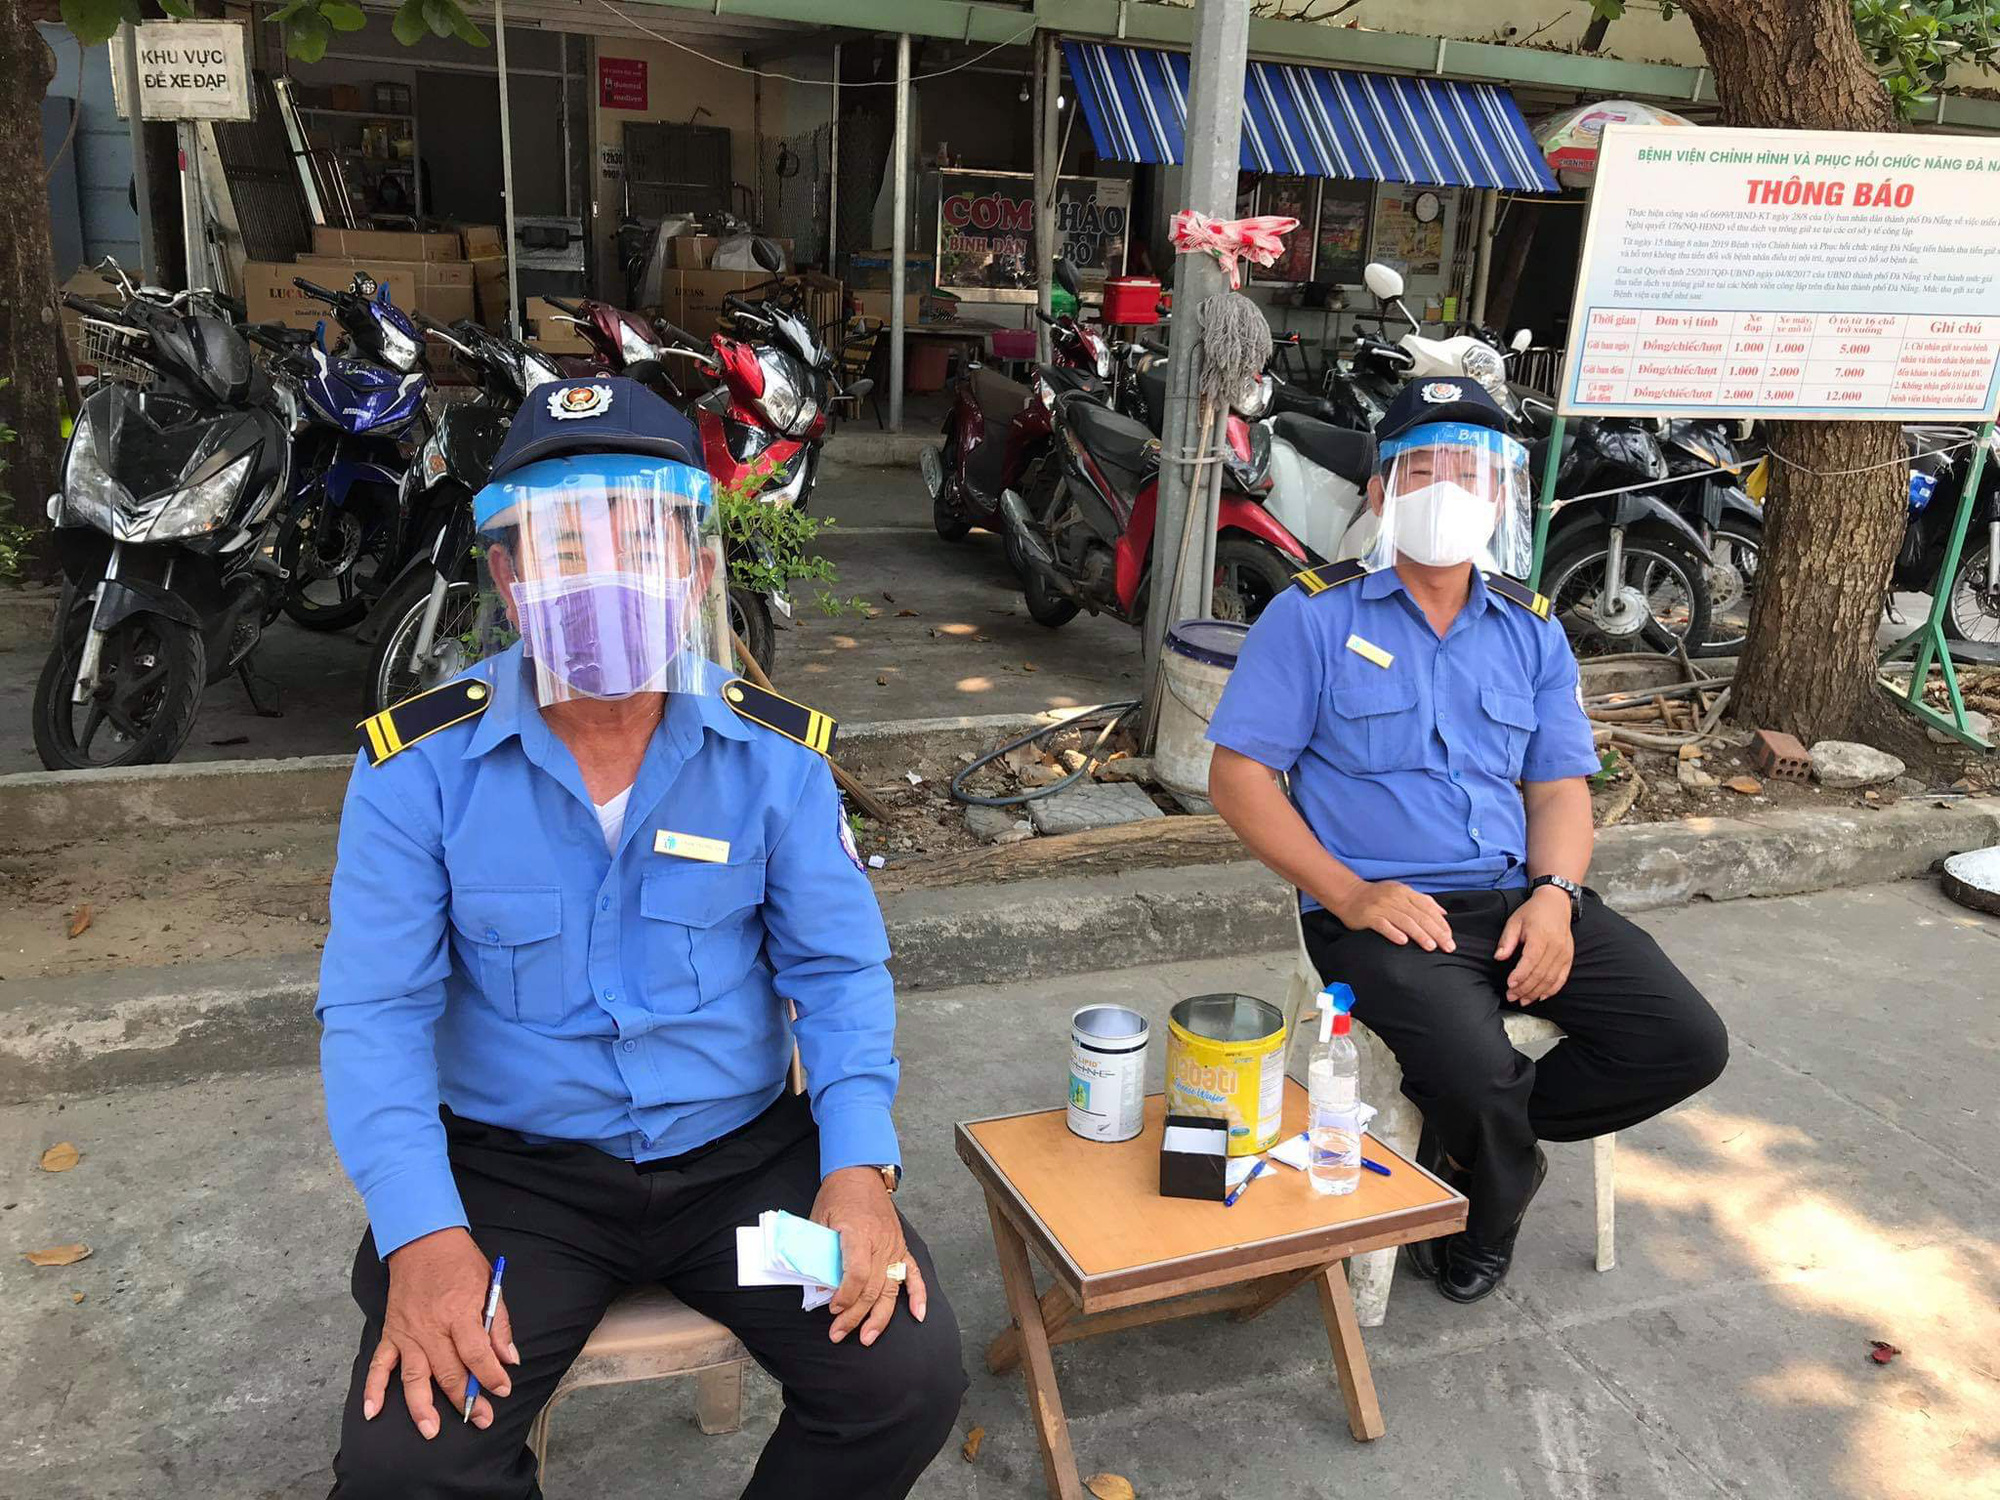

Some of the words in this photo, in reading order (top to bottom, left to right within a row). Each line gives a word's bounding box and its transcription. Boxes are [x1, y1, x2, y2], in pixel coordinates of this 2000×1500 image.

[142, 50, 178, 64] KHU
[184, 50, 222, 67] VỰC
[170, 74, 192, 87] XE
[194, 74, 226, 91] ĐẠP
[1638, 146, 1672, 163] BỆNH
[1677, 147, 1706, 165] VIỆN
[1710, 148, 1752, 163] CHỈNH
[1757, 150, 1789, 164] HÌNH
[1794, 151, 1810, 165] VÀ
[1815, 155, 1851, 169] PHỤC
[1855, 150, 1879, 167] HỒI
[1882, 154, 1921, 168] CHỨC
[1925, 156, 1962, 170] NĂNG
[1966, 157, 1983, 170] ĐÀ
[1747, 175, 1845, 205] THÔNG
[1853, 178, 1914, 207] BÁO
[943, 191, 1033, 230] CƠM
[1055, 195, 1124, 235] HÁO
[950, 233, 987, 252] BÌNH
[992, 234, 1028, 255] DÂN
[268, 288, 310, 299] LUCA
[1593, 313, 1613, 324] Thời
[1616, 316, 1636, 326] gian
[1656, 315, 1678, 326] Đơn
[1683, 316, 1693, 328] vị
[1696, 316, 1718, 327] tính
[1931, 321, 1955, 333] Ghi
[1959, 322, 1982, 334] chú
[1643, 339, 1722, 354] Đồng/chiếc/lượt
[1735, 342, 1764, 352] 1.000
[1776, 343, 1804, 353] 1.000
[1840, 344, 1870, 354] 5.000
[1638, 363, 1717, 378] Đồng/chiếc/lượt
[1730, 366, 1758, 376] 1.000
[1770, 367, 1799, 376] 2.000
[1835, 368, 1865, 377] 7.000
[1634, 386, 1712, 401] Đồng/chiếc/lượt
[1724, 390, 1754, 399] 2.000
[1764, 390, 1794, 400] 3.000
[1826, 391, 1862, 401] 12.000
